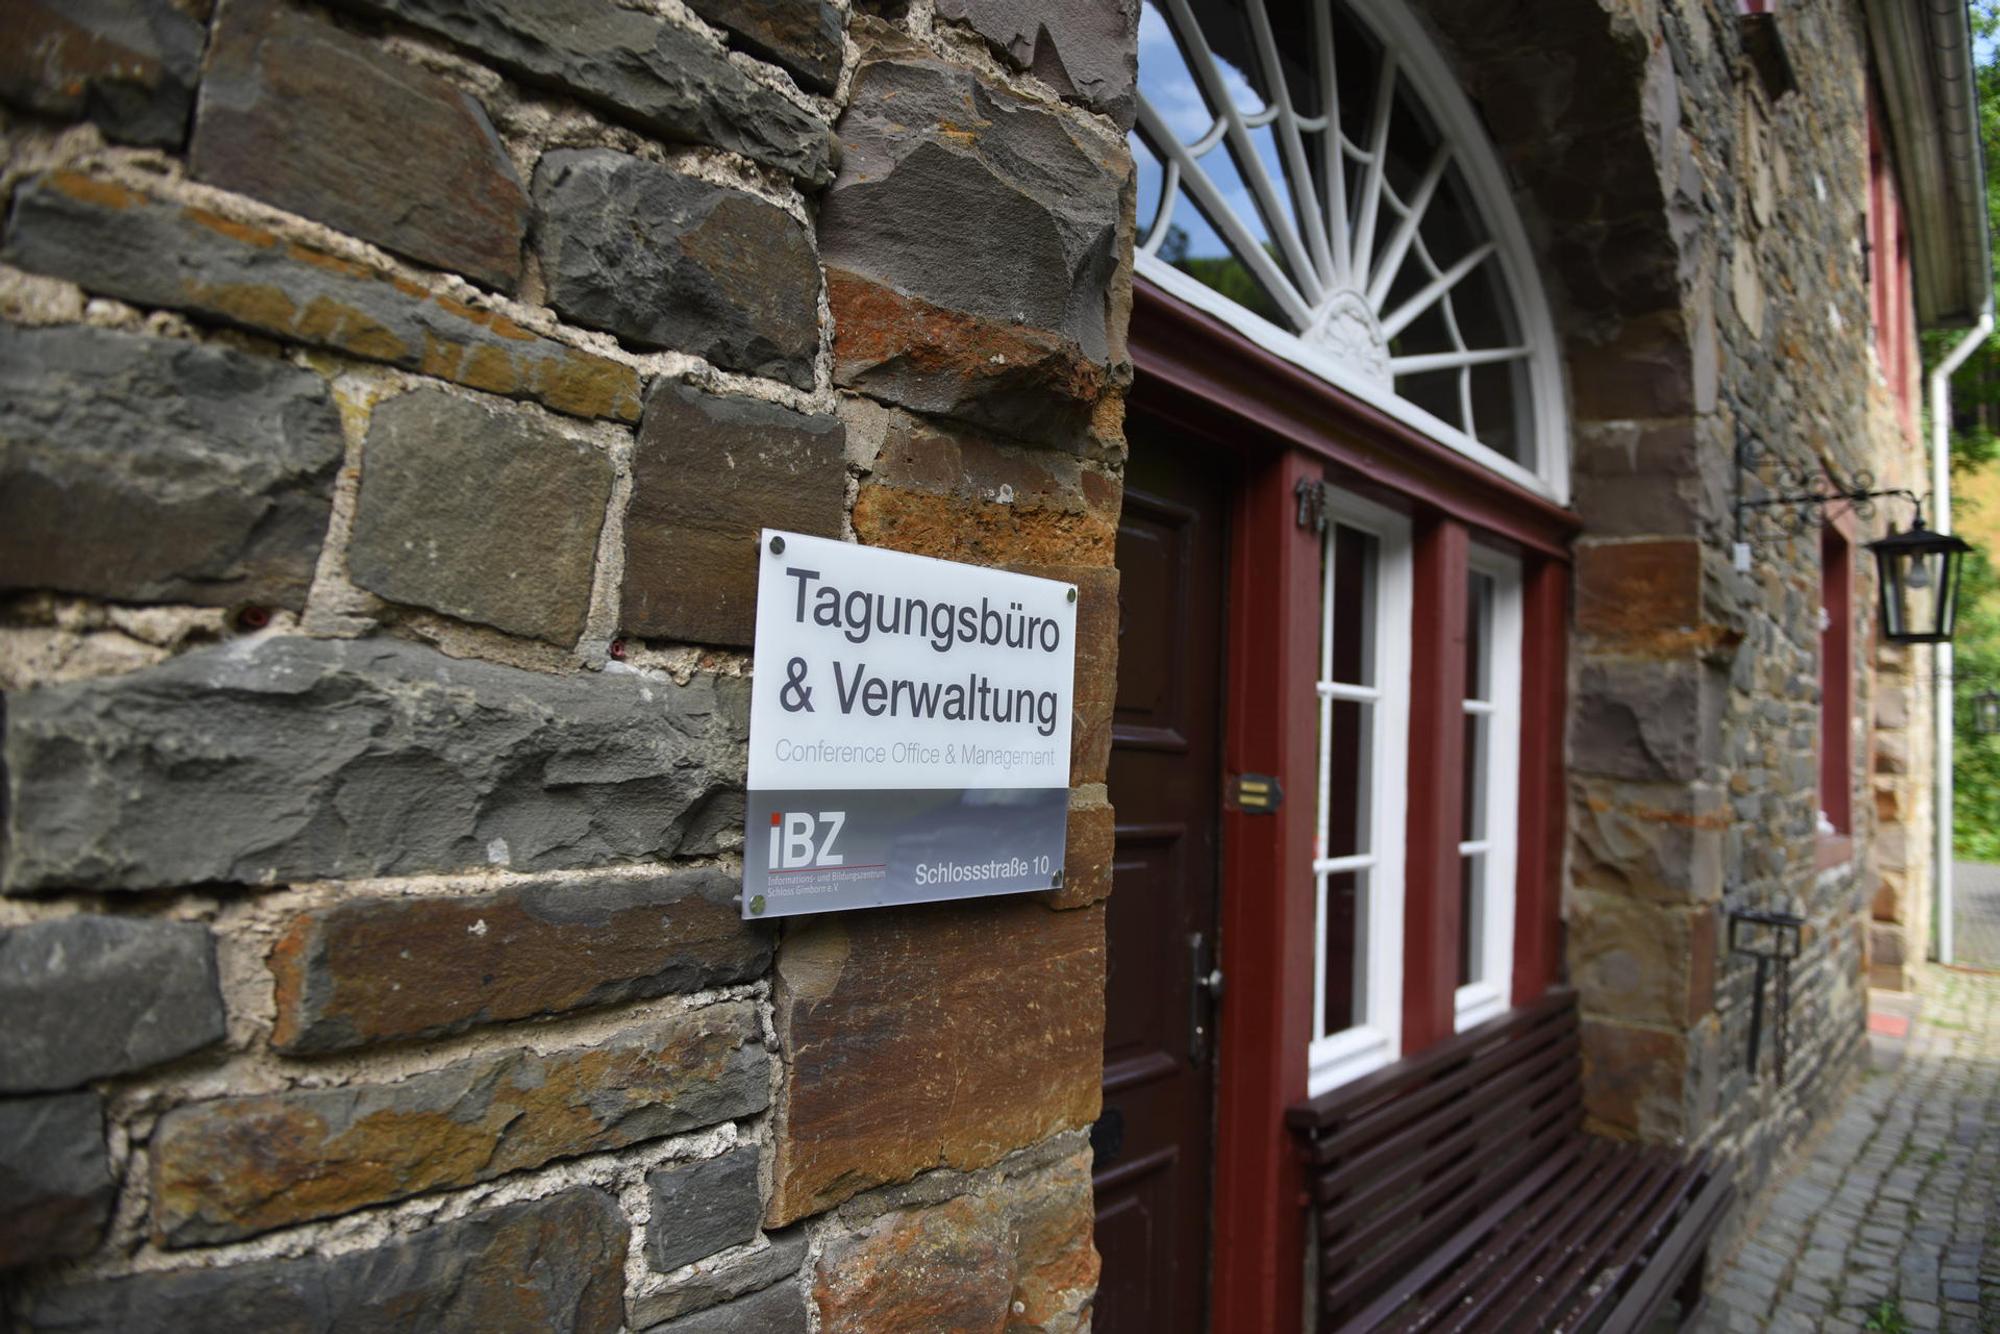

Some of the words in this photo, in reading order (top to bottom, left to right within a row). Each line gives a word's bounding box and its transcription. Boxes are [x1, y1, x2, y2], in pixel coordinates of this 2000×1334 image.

[786, 567, 1060, 653] Tagungsbüro
[779, 656, 815, 713] &
[832, 661, 1058, 737] Verwaltung
[775, 738, 886, 765] Conference
[892, 742, 940, 765] Office
[944, 744, 957, 765] &
[961, 744, 1056, 770] Management
[817, 873, 831, 883] und
[831, 870, 886, 882] Bildungszentrum
[914, 858, 1029, 886] Schlossstraße
[1032, 855, 1050, 876] 10
[767, 886, 795, 898] Schloss
